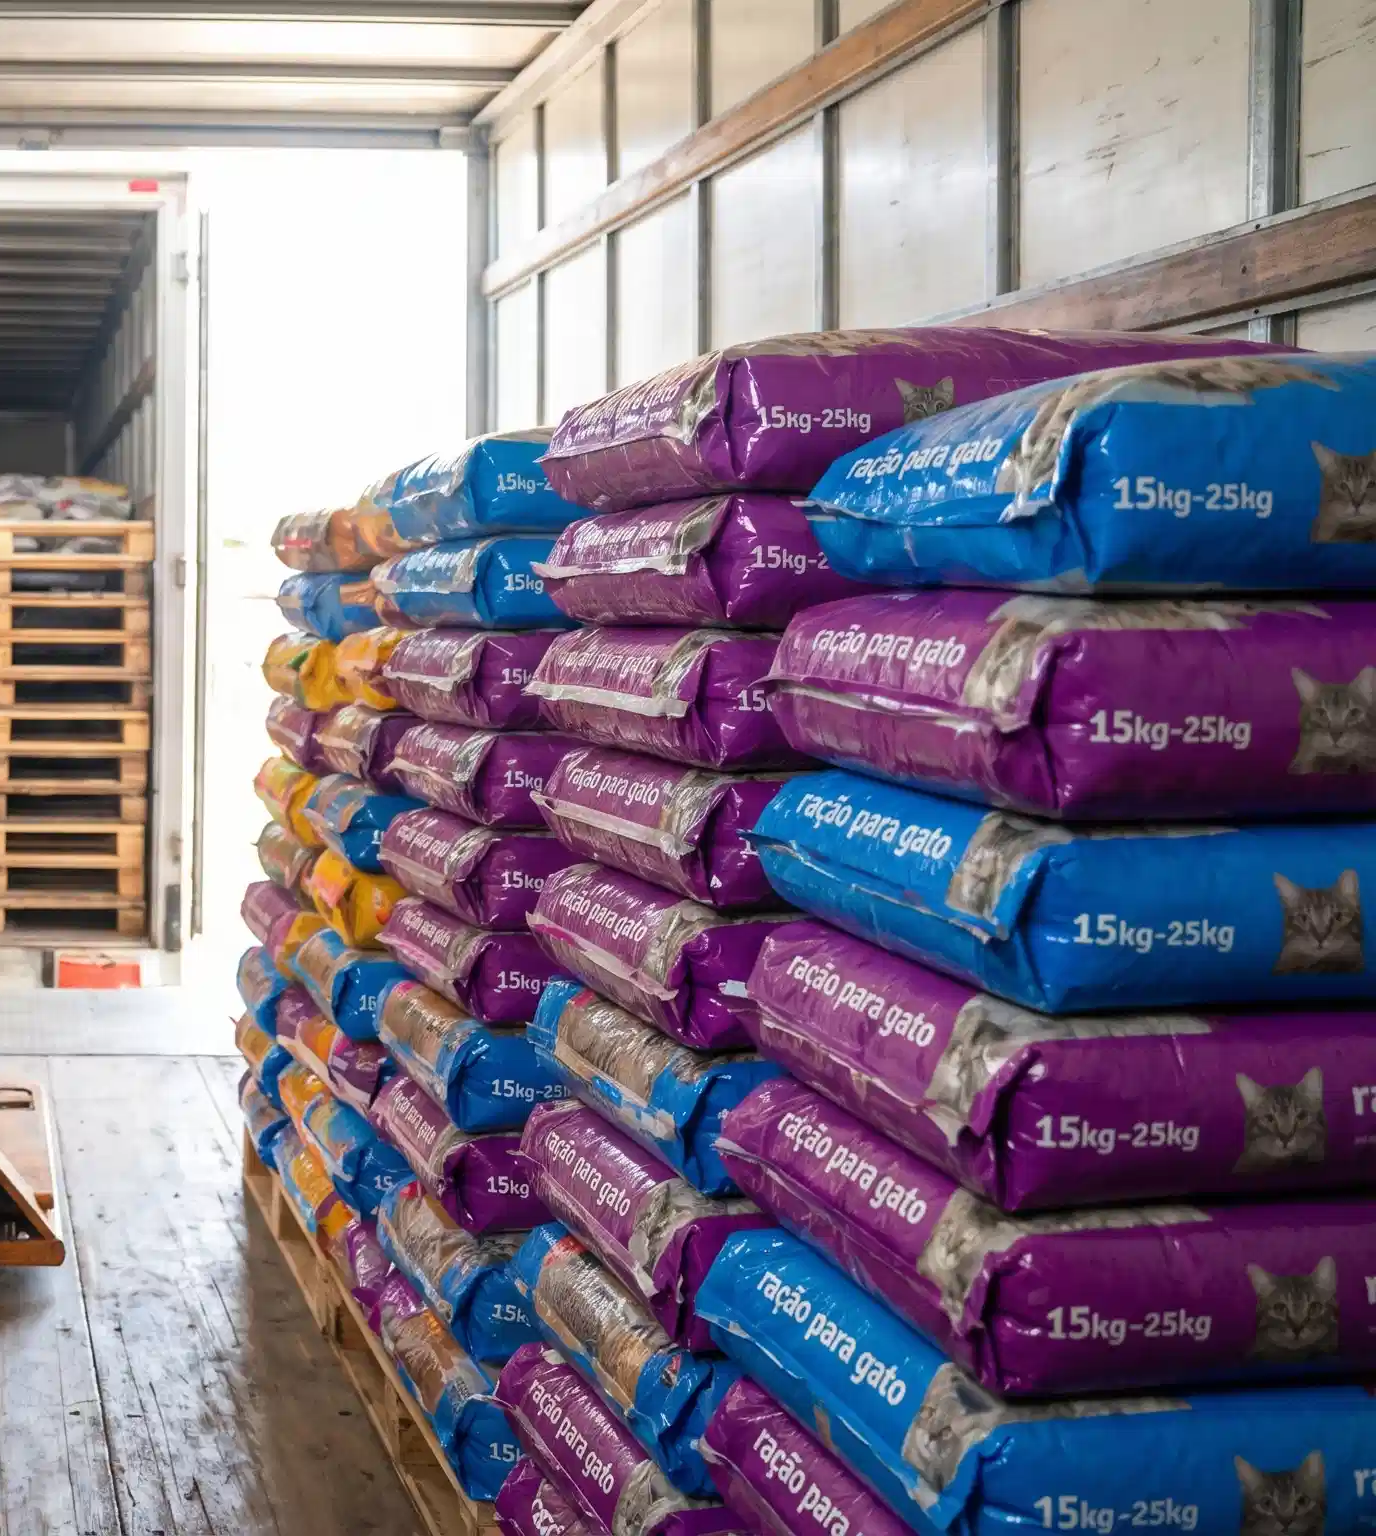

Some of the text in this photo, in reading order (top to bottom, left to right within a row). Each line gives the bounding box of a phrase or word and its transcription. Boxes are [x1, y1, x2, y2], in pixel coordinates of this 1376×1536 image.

[757, 405, 872, 435] 15kg-25kg
[847, 438, 1003, 484] ração para gato
[1112, 476, 1273, 519] 15kg-25kg
[812, 623, 966, 672] ração para gato
[1088, 708, 1252, 751] 15kg-25kg
[503, 770, 544, 792] 15kg
[597, 775, 629, 798] para
[624, 780, 660, 806] gato
[795, 792, 953, 860] ração para gato
[501, 870, 545, 892] 15kg
[584, 903, 618, 926] para
[611, 915, 649, 942] gato
[1072, 913, 1235, 953] 15kg-25kg
[785, 953, 936, 1048] ração para gato
[1035, 1114, 1200, 1155] 15kg-25kg
[486, 1175, 530, 1199] 15kg
[545, 1131, 632, 1217] ração para gato
[777, 1111, 928, 1225] ração para gato
[756, 1271, 907, 1407] ração para gato
[1046, 1305, 1213, 1346] 15kg-25kg
[529, 1379, 615, 1495] ração para gato
[752, 1427, 851, 1536] ração para
[1033, 1494, 1199, 1534] 15kg-25kg
